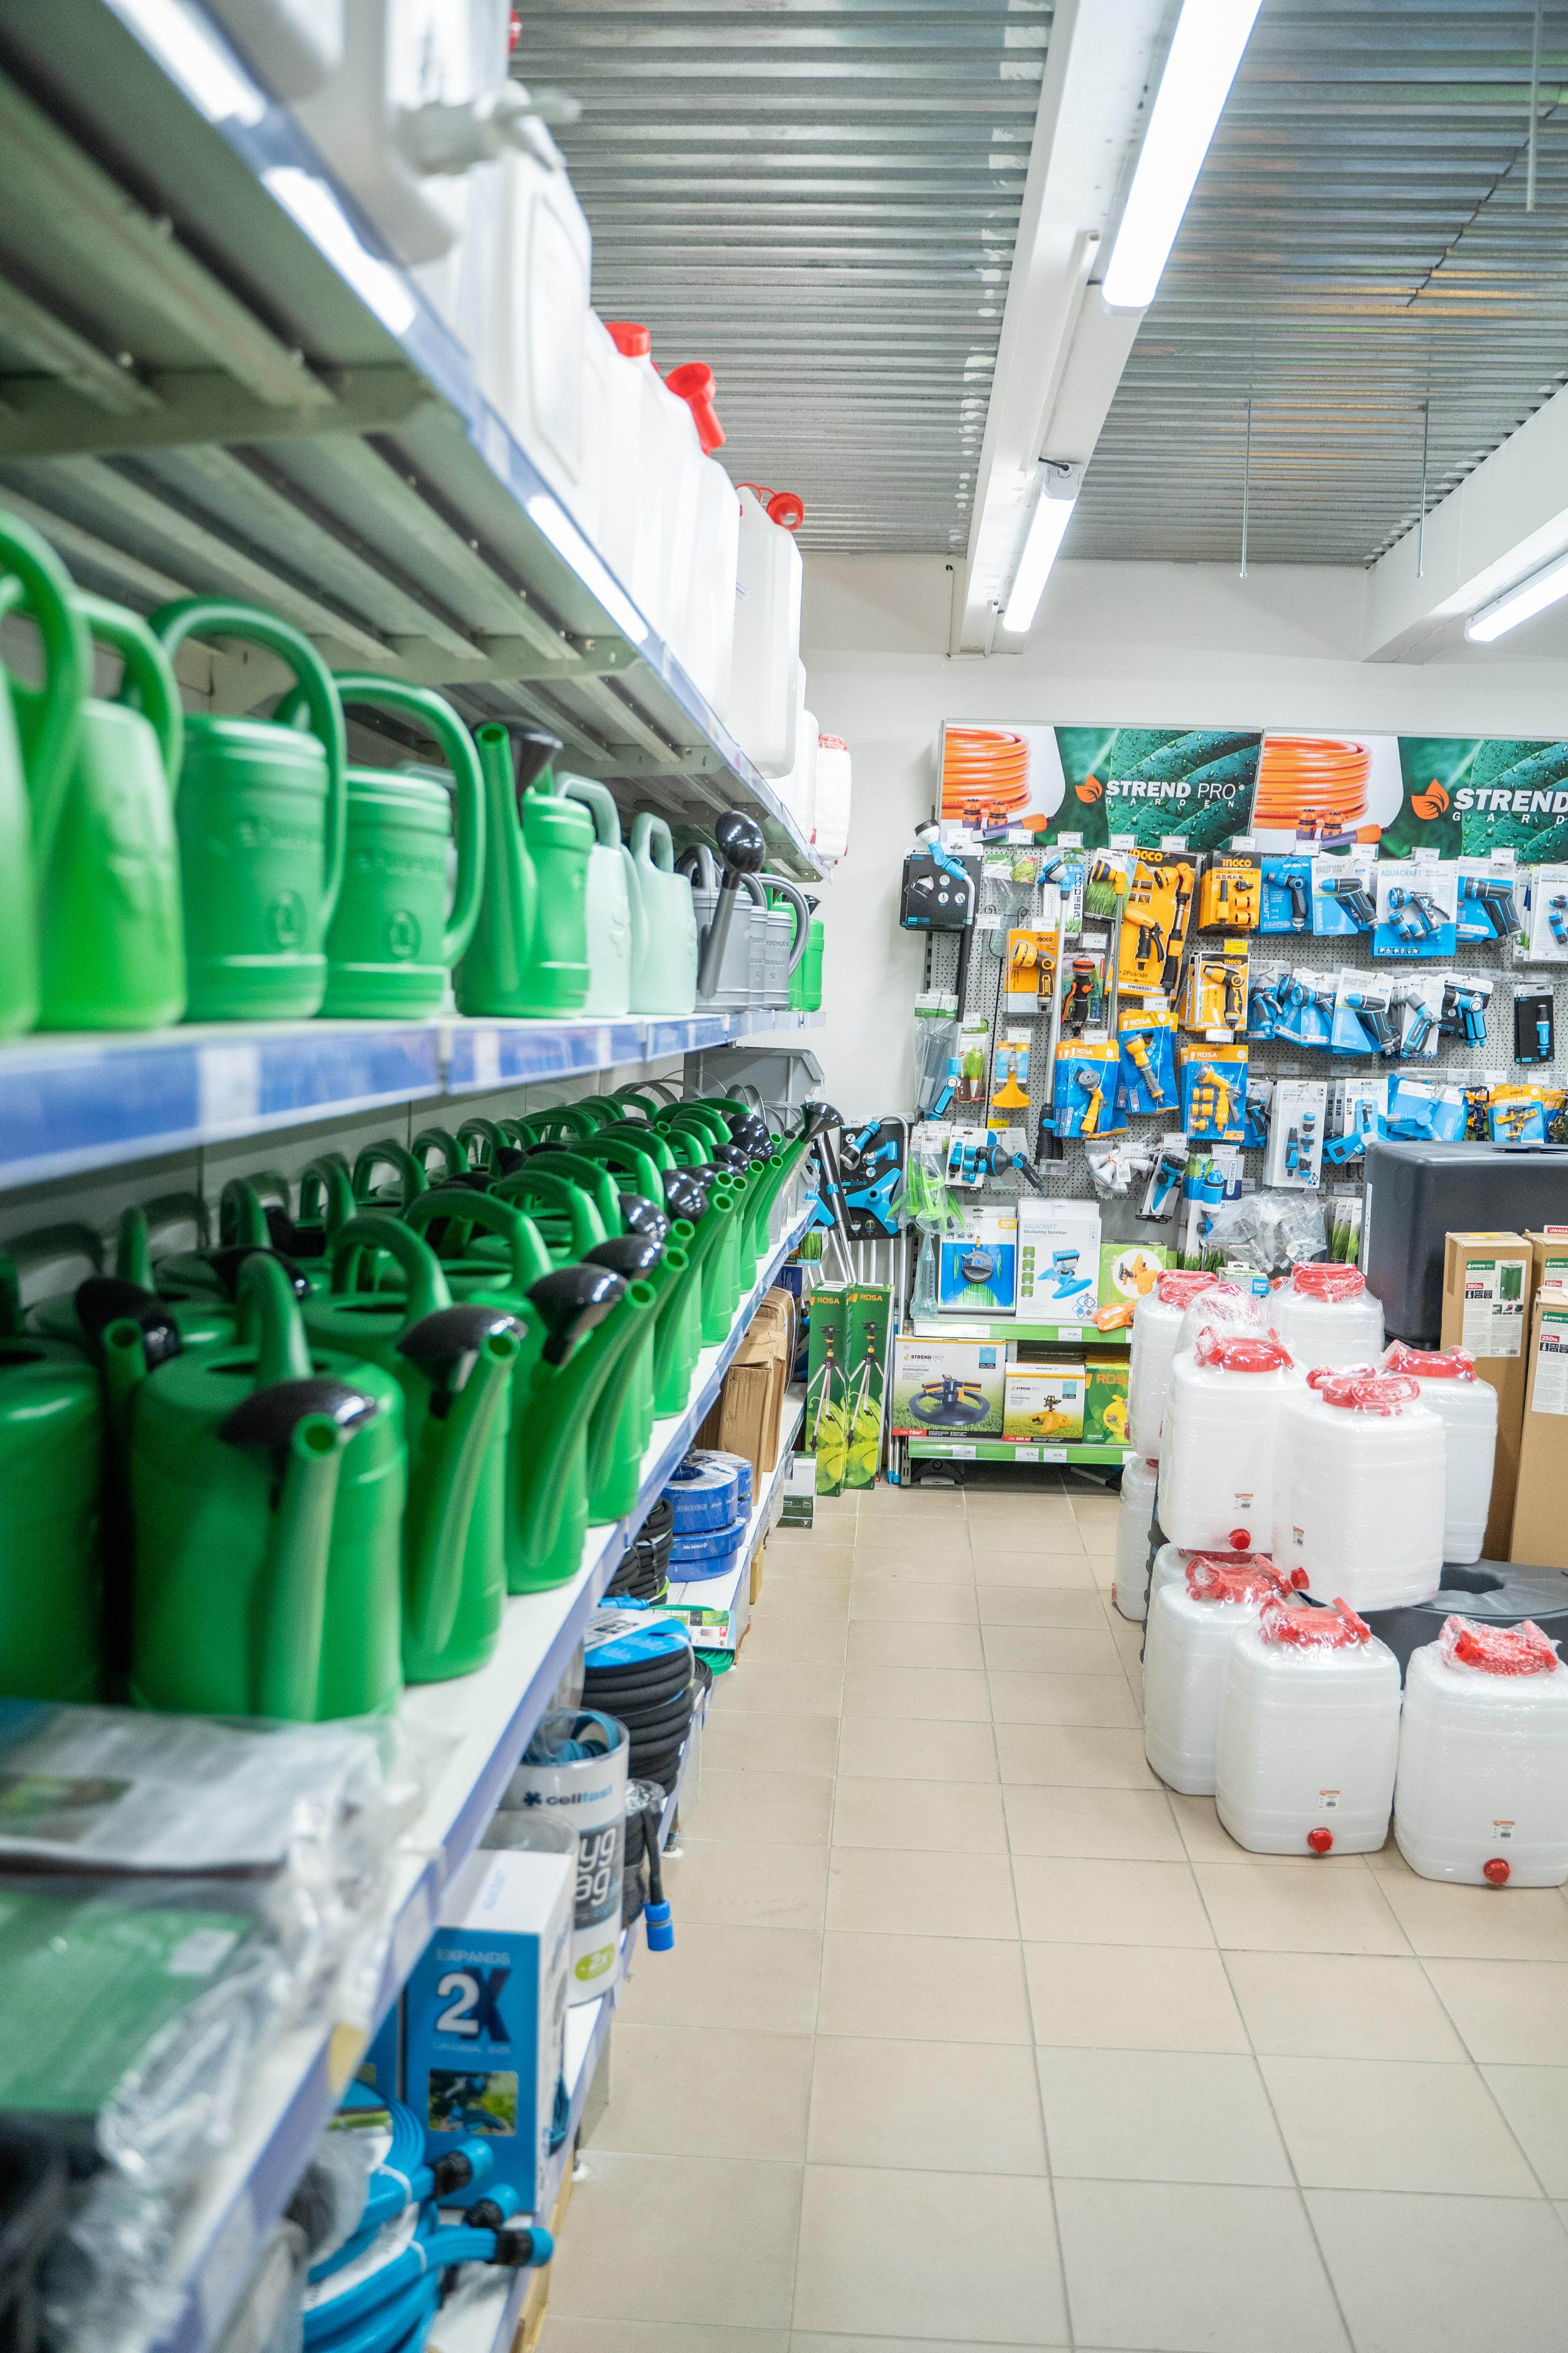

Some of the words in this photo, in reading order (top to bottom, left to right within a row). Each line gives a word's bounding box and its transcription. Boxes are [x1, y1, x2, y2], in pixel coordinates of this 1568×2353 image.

[1105, 780, 1191, 798] STREND
[1453, 788, 1568, 813] STREND
[1122, 970, 1148, 979] 2Pcs/set
[1343, 976, 1372, 985] ADJUSTABLE
[546, 1783, 614, 1806] cellfast
[435, 1947, 511, 1966] EXPANDS
